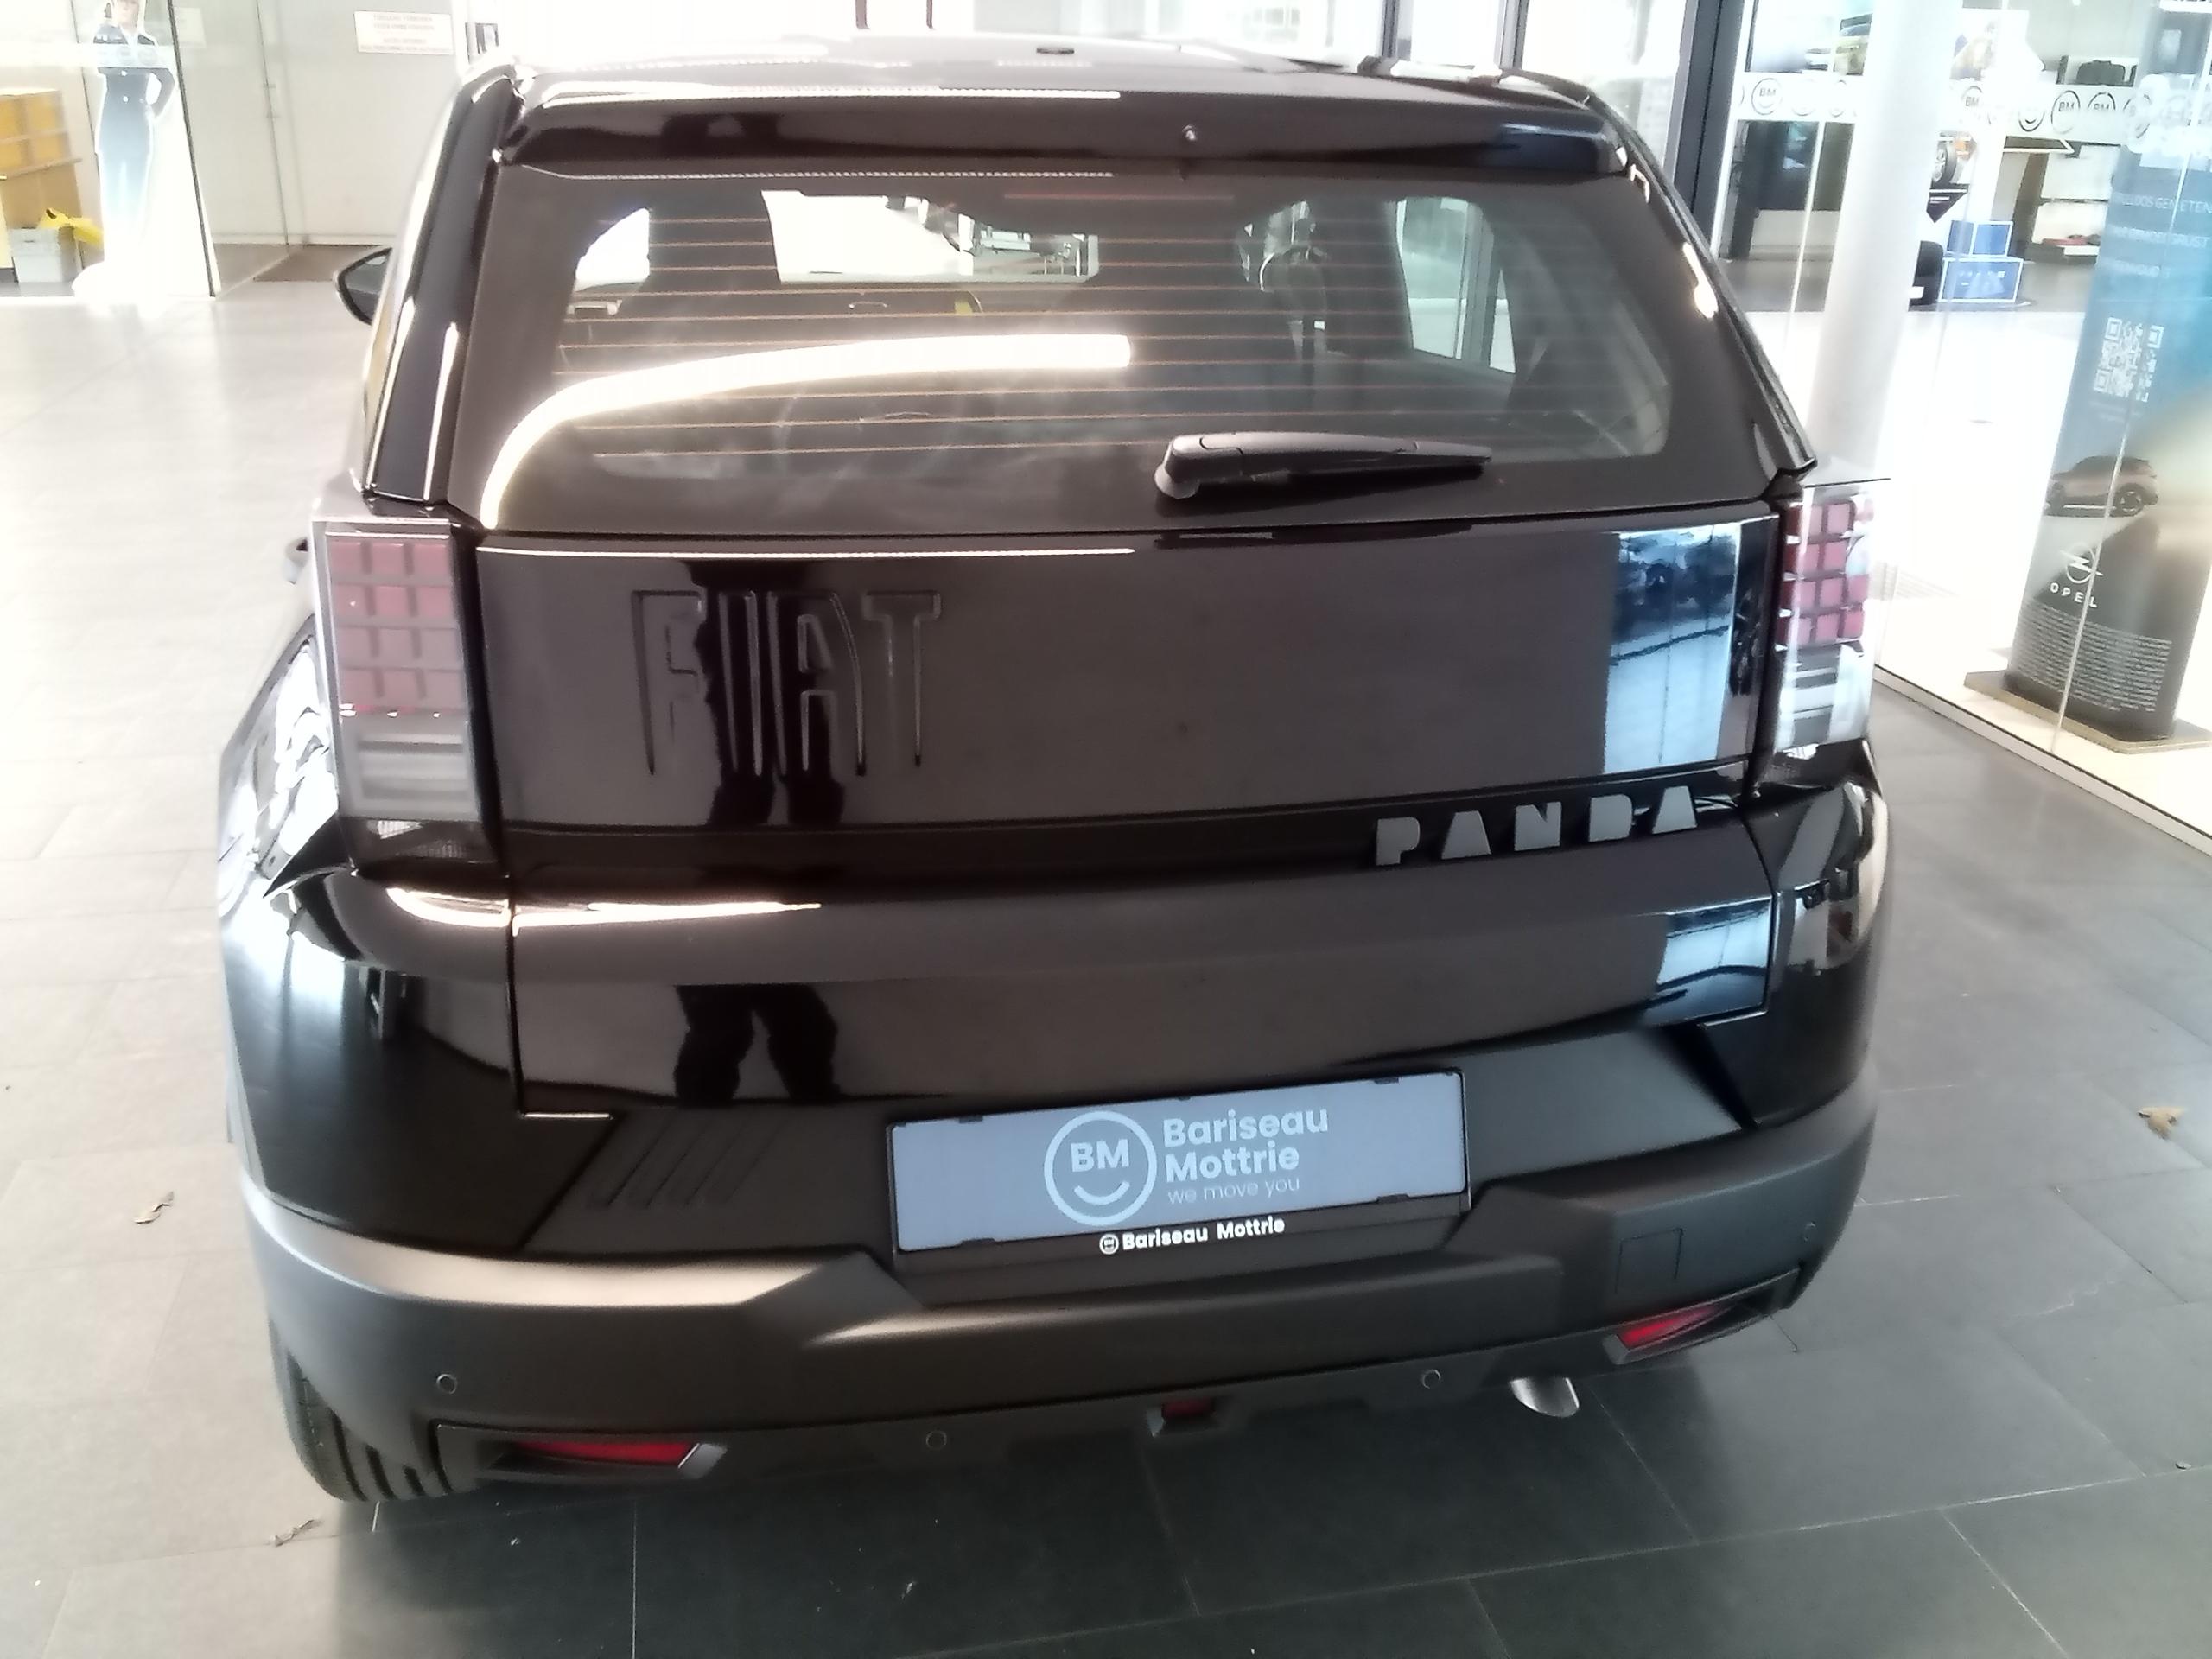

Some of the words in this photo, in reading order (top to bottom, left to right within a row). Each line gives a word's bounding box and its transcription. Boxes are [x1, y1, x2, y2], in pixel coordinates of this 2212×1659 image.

[2058, 101, 2075, 112] BM
[2050, 582, 2098, 607] OPEL
[631, 589, 944, 776] FIAT
[1376, 785, 1697, 866] PANDA
[1163, 1108, 1329, 1148] Bariseau
[1071, 1138, 1130, 1173] BM
[1165, 1139, 1300, 1183] Mottrie
[1167, 1188, 1198, 1205] we
[1203, 1181, 1260, 1200] move
[1264, 1177, 1300, 1198] you
[1122, 1227, 1209, 1250] Bariseau
[1217, 1215, 1286, 1240] Mottrie
